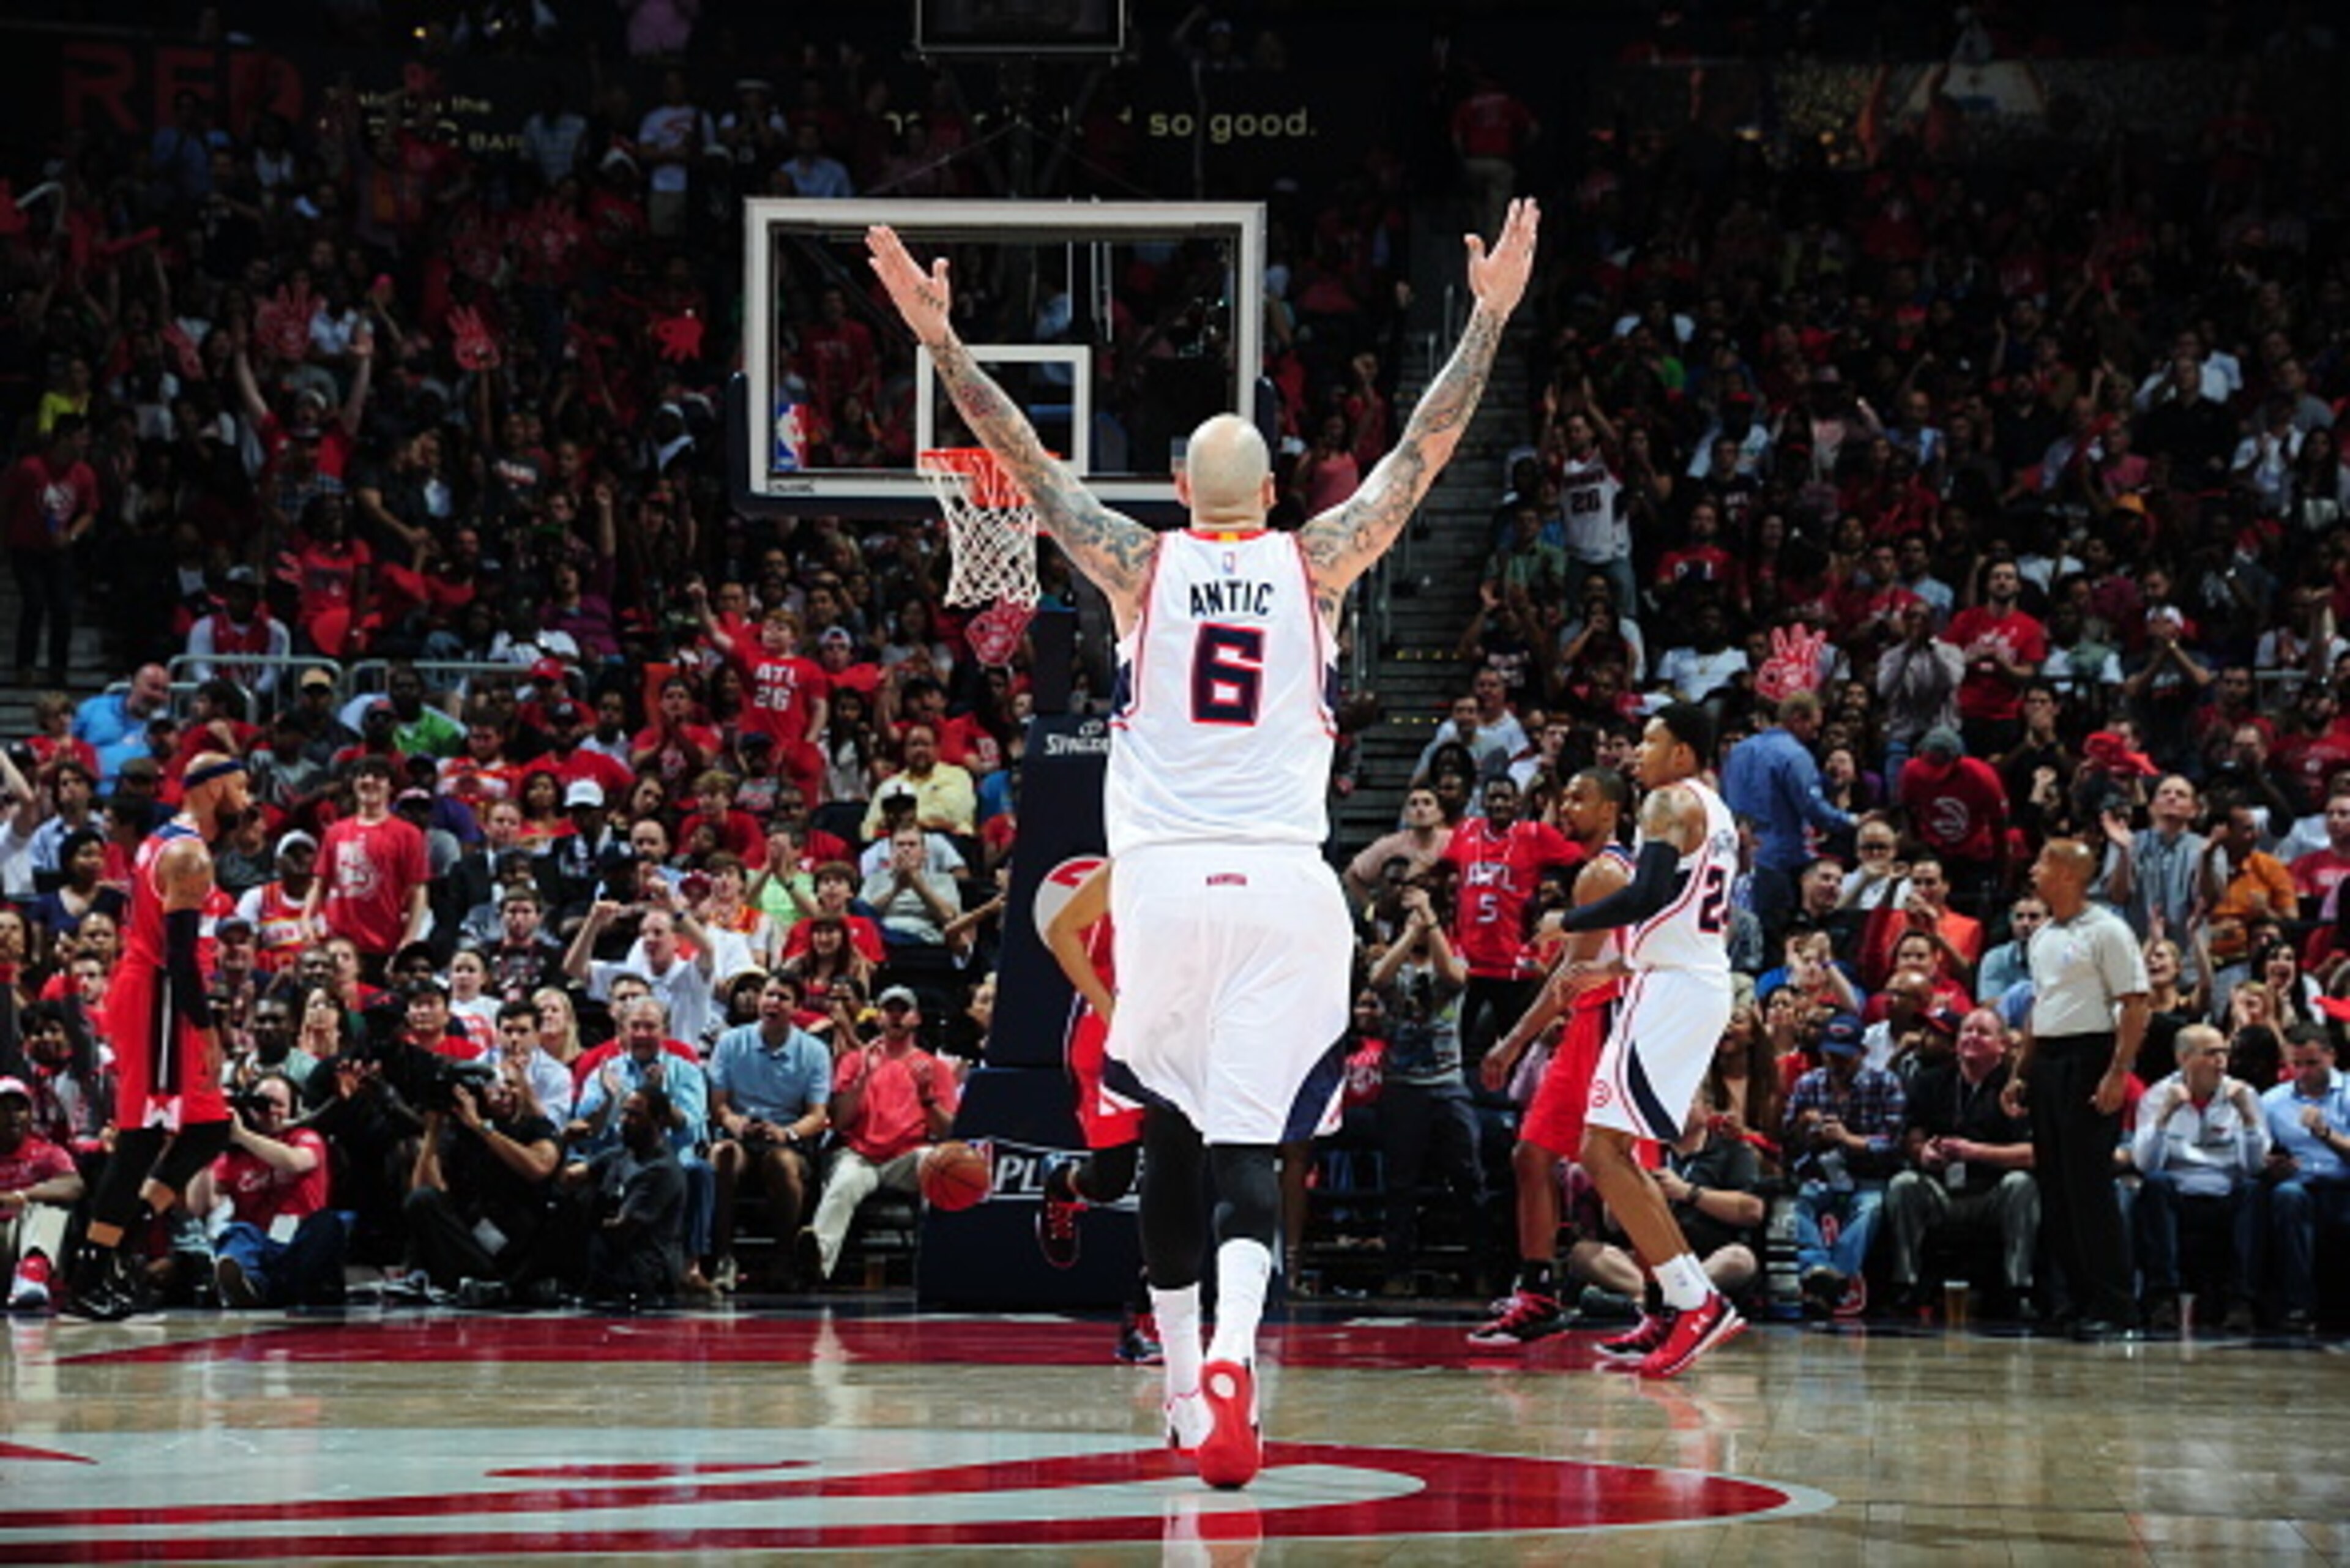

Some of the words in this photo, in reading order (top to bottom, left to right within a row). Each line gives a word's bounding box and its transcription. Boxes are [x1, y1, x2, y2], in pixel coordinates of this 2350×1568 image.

[62, 41, 304, 136] RED
[1149, 113, 1194, 138] so
[1209, 106, 1318, 145] good.
[1190, 580, 1273, 616] ANTIC
[755, 662, 799, 687] ATL
[1191, 621, 1264, 726] 6
[754, 685, 791, 711] 26
[1477, 893, 1498, 923] 5
[1698, 865, 1731, 933] 2
